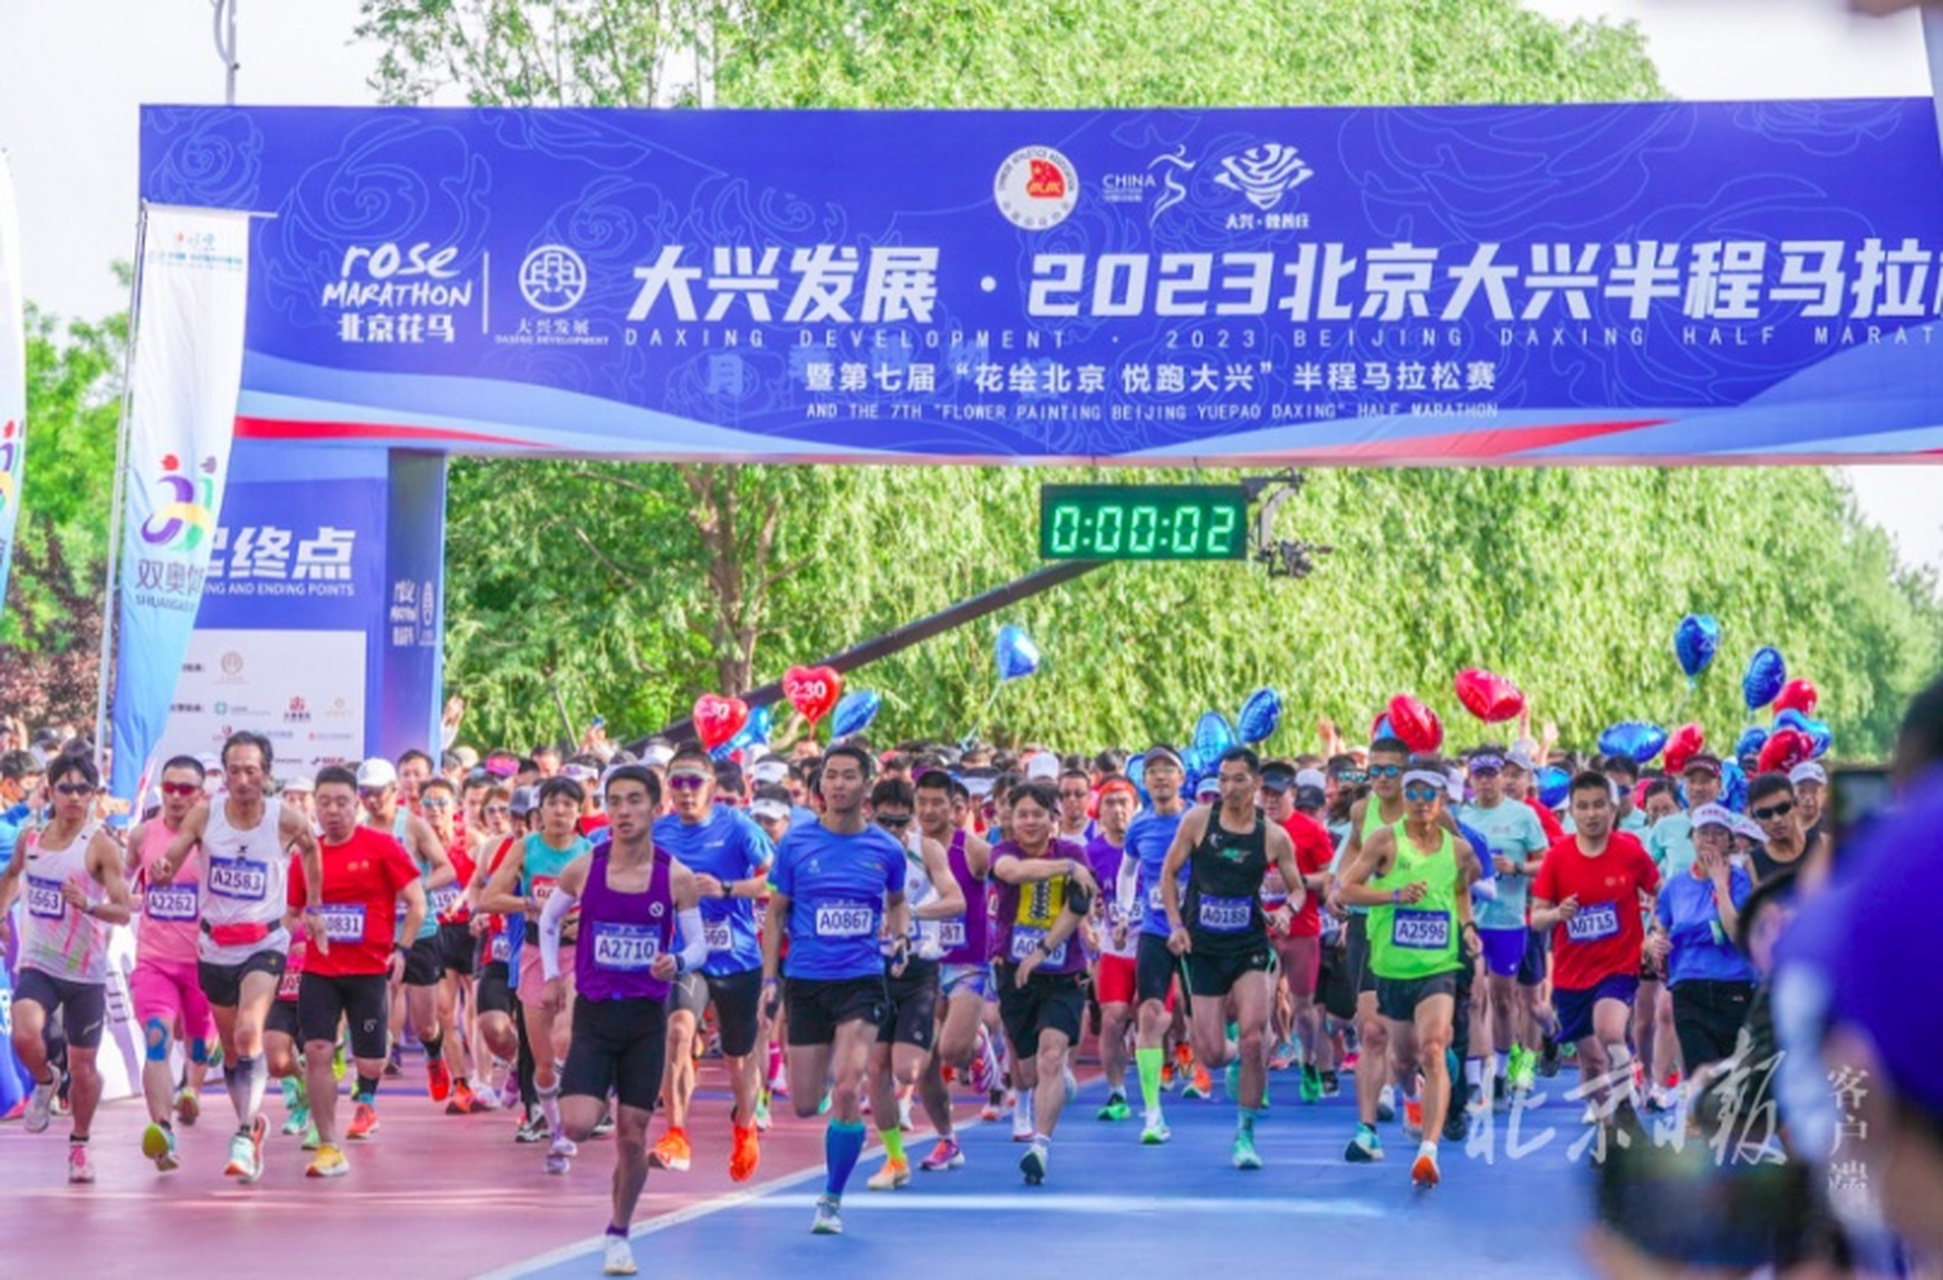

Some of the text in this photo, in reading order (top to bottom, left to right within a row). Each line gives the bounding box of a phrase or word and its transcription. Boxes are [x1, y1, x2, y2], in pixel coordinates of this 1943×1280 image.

[1102, 174, 1156, 188] CHINA
[341, 241, 461, 279] rose
[625, 238, 1943, 323] 大兴发展·2023北京大兴半程马拉
[322, 280, 472, 308] MARATHON
[337, 313, 454, 343] 北京花马
[625, 329, 764, 347] DAXING
[800, 330, 1066, 349] DEVELOPMENT
[1166, 331, 1257, 349] 2023
[1293, 329, 1464, 348] BEIJING
[1500, 327, 1645, 346] DAXING
[1683, 327, 1777, 346] HALF
[806, 404, 838, 419] AND
[849, 404, 880, 419] THE
[891, 404, 923, 419] 7TH
[1017, 405, 1100, 420] PAINTING
[1112, 404, 1186, 420] BEIJING
[1199, 404, 1261, 420] YUEPAO
[1357, 402, 1402, 418] HALF
[1411, 401, 1498, 418] MARATHON
[1051, 505, 1235, 554] 0:00:02
[228, 582, 255, 596] AND
[257, 582, 304, 597] ENDING
[308, 582, 355, 597] POINTS
[213, 869, 261, 891] A2583
[820, 911, 873, 929] A0867
[1397, 922, 1446, 940] A2596
[599, 938, 654, 959] A2710
